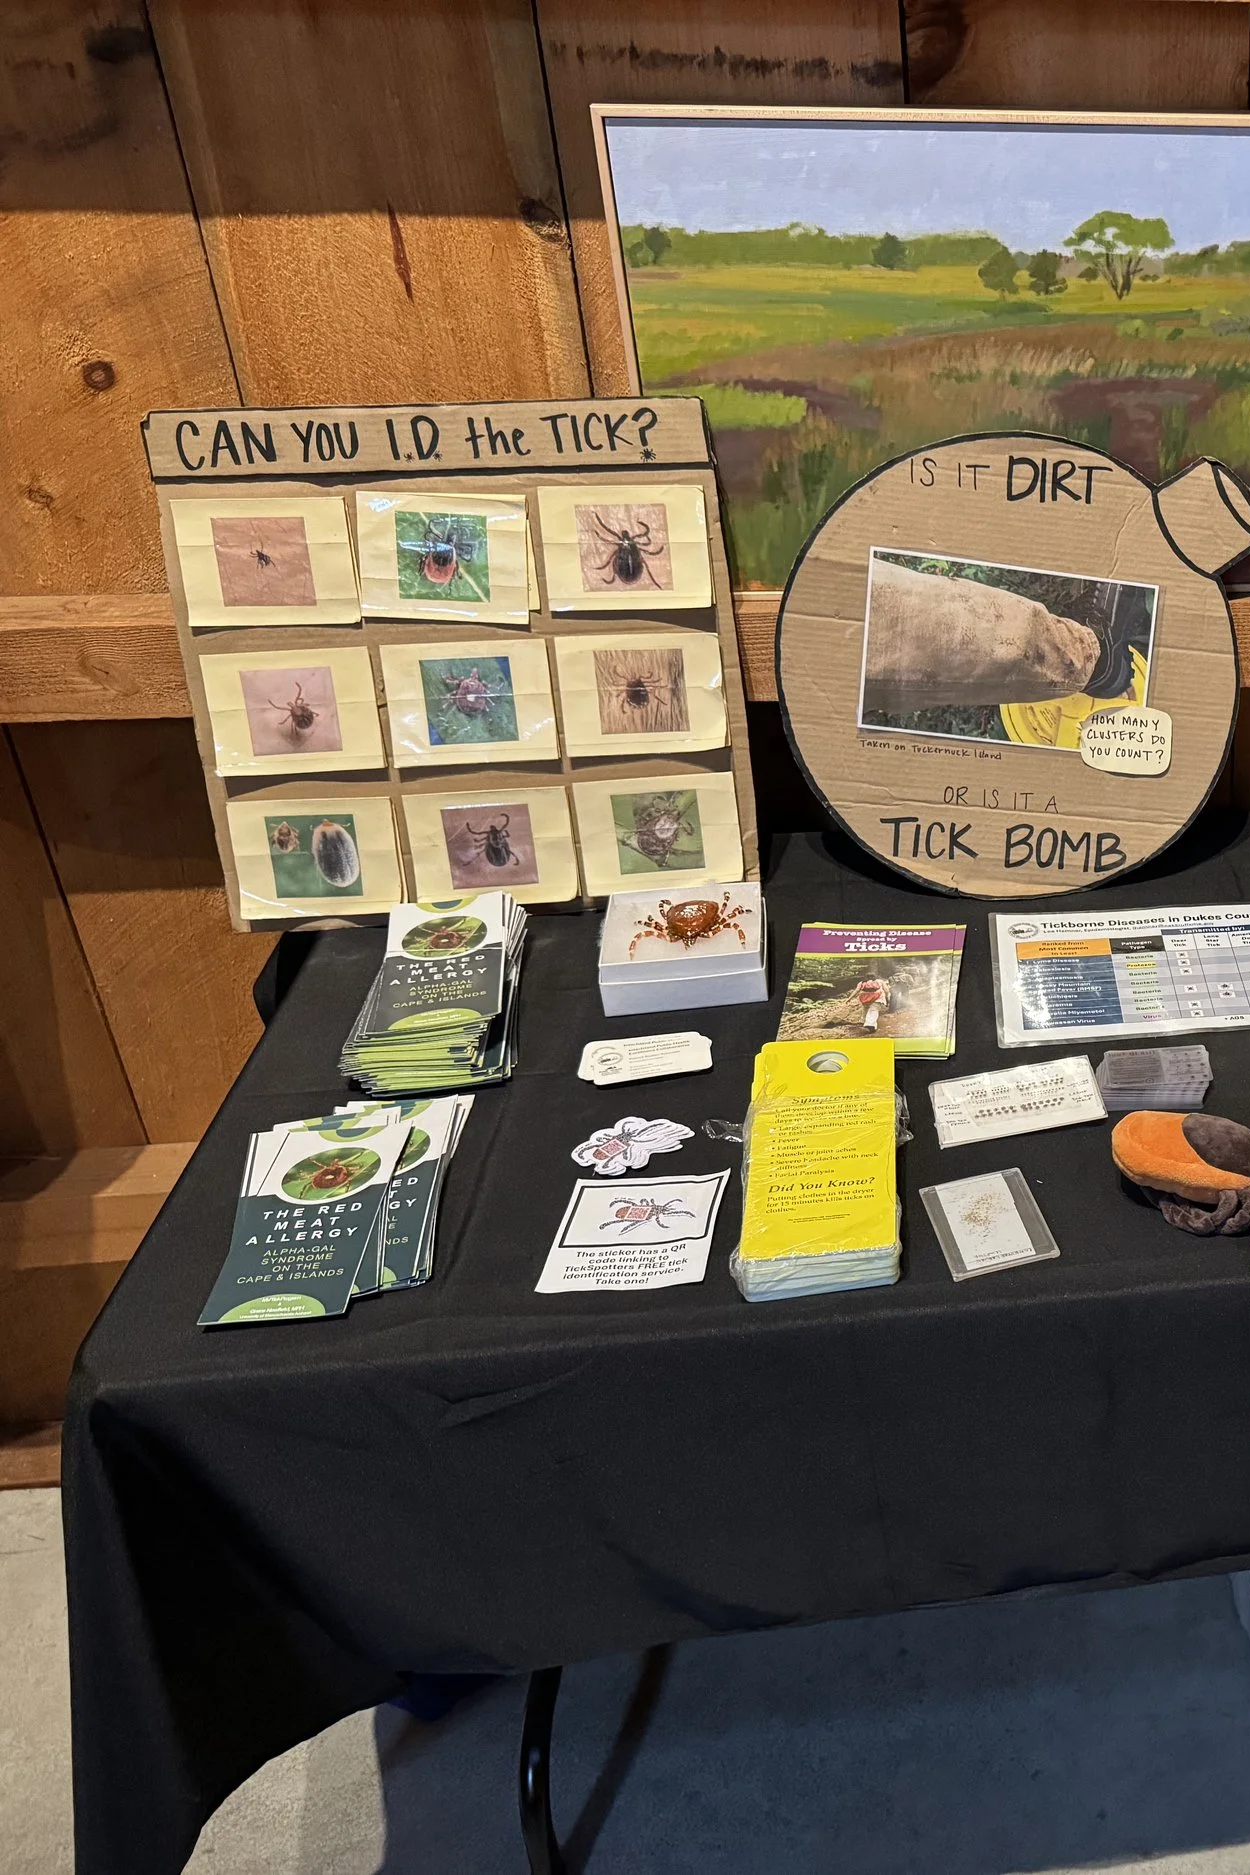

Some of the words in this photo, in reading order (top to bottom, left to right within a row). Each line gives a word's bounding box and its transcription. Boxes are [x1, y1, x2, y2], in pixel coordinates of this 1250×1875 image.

[176, 420, 277, 470] CAN
[290, 419, 359, 463] YOU
[464, 416, 532, 459] the
[539, 406, 659, 462] TICK?
[910, 457, 937, 488] IS
[957, 462, 991, 491] IT
[1006, 455, 1114, 505] DIRT
[1091, 713, 1119, 726] HOW
[1122, 714, 1161, 731] MANY
[1086, 728, 1144, 744] CLUSTERS
[1151, 734, 1167, 746] DO
[1089, 745, 1111, 760] YOU
[943, 785, 969, 806] OR
[983, 788, 1000, 810] IS
[1013, 791, 1035, 811] IT
[1044, 795, 1059, 814] A
[879, 816, 980, 860] TICK
[1003, 823, 1128, 874] BOMB
[1040, 921, 1106, 929] Tickborne
[1108, 917, 1166, 927] Diseases
[1168, 915, 1179, 923] in
[1182, 913, 1222, 923] Dukes
[822, 929, 887, 938] Preventing
[844, 942, 907, 952] Ticks
[396, 961, 434, 971] THE
[446, 955, 485, 965] RED
[411, 962, 468, 976] MEAT
[389, 967, 488, 986] ALLERGY
[768, 1183, 795, 1194] Did
[799, 1182, 823, 1191] You
[827, 1176, 876, 1188] Know?
[263, 1207, 305, 1220] THE
[317, 1202, 362, 1215] RED
[273, 1216, 340, 1231] MEAT
[245, 1226, 359, 1246] ALLERGY
[263, 1244, 337, 1257] ALPHA-GAL
[598, 1249, 637, 1257] sticker
[670, 1243, 687, 1252] QR
[261, 1252, 334, 1265] SYNDROME
[564, 1263, 635, 1273] TickSpotters
[637, 1261, 666, 1270] FREE
[668, 1257, 688, 1267] tick
[618, 1255, 656, 1263] linking
[272, 1265, 291, 1273] ON
[296, 1261, 321, 1270] THE
[562, 1270, 638, 1280] identification
[640, 1267, 685, 1277] service.
[236, 1274, 273, 1284] CAPE
[276, 1273, 284, 1281] &
[288, 1268, 345, 1280] ISLANDS
[623, 1277, 649, 1285] one!
